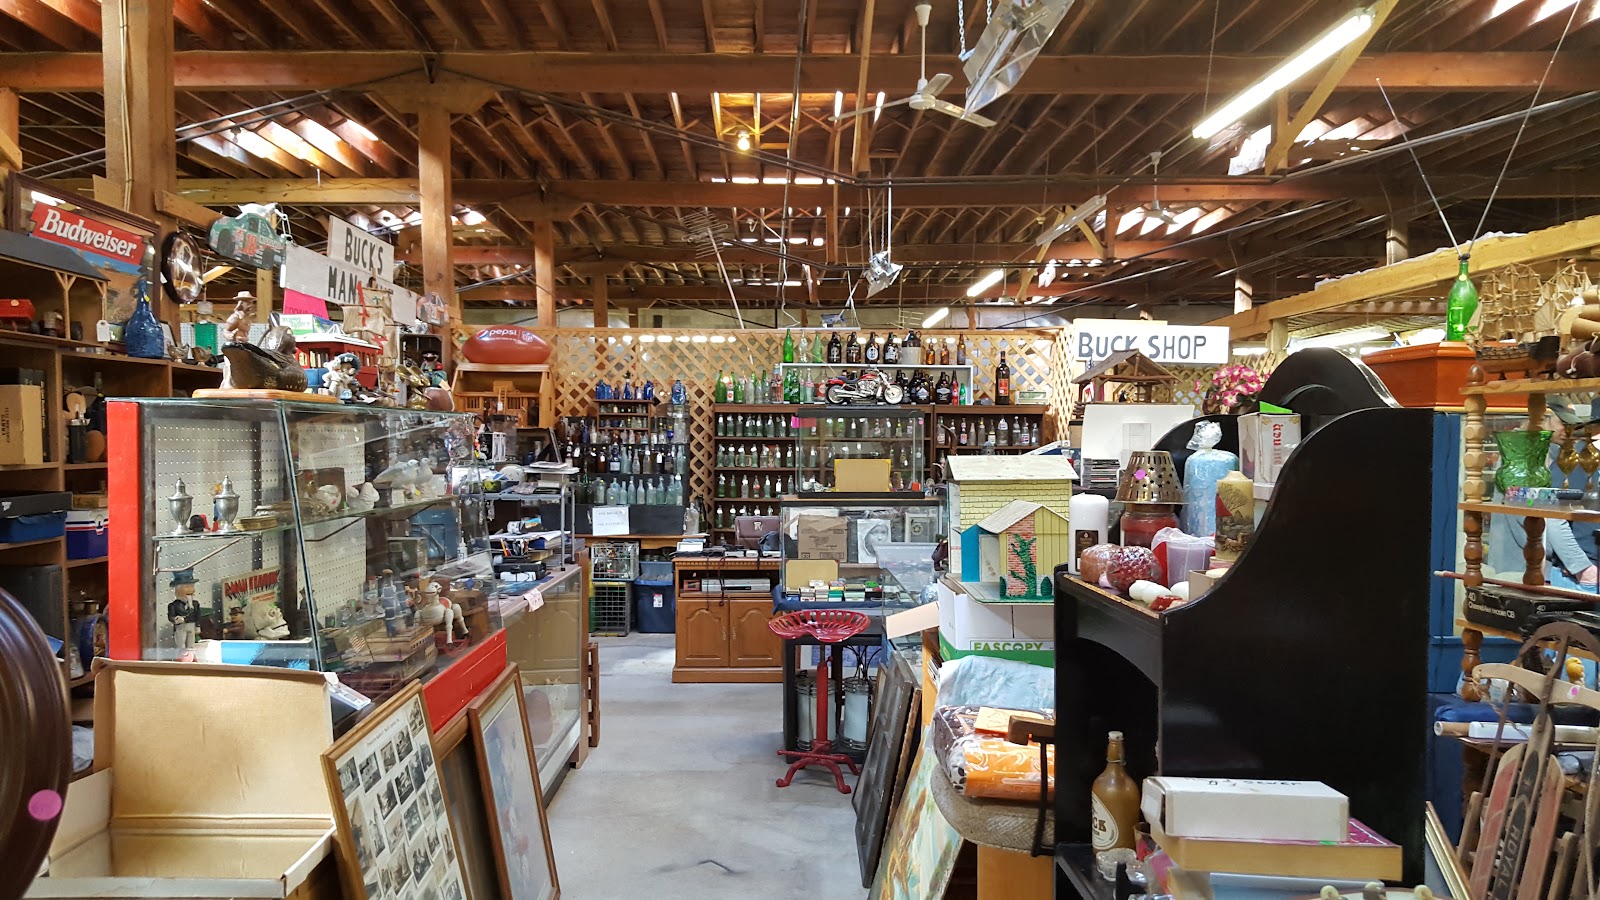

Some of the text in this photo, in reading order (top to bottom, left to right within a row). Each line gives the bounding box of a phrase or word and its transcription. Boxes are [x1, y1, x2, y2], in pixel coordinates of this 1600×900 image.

[40, 208, 137, 257] Budweiser
[1078, 332, 1207, 360] BUCK SHOP
